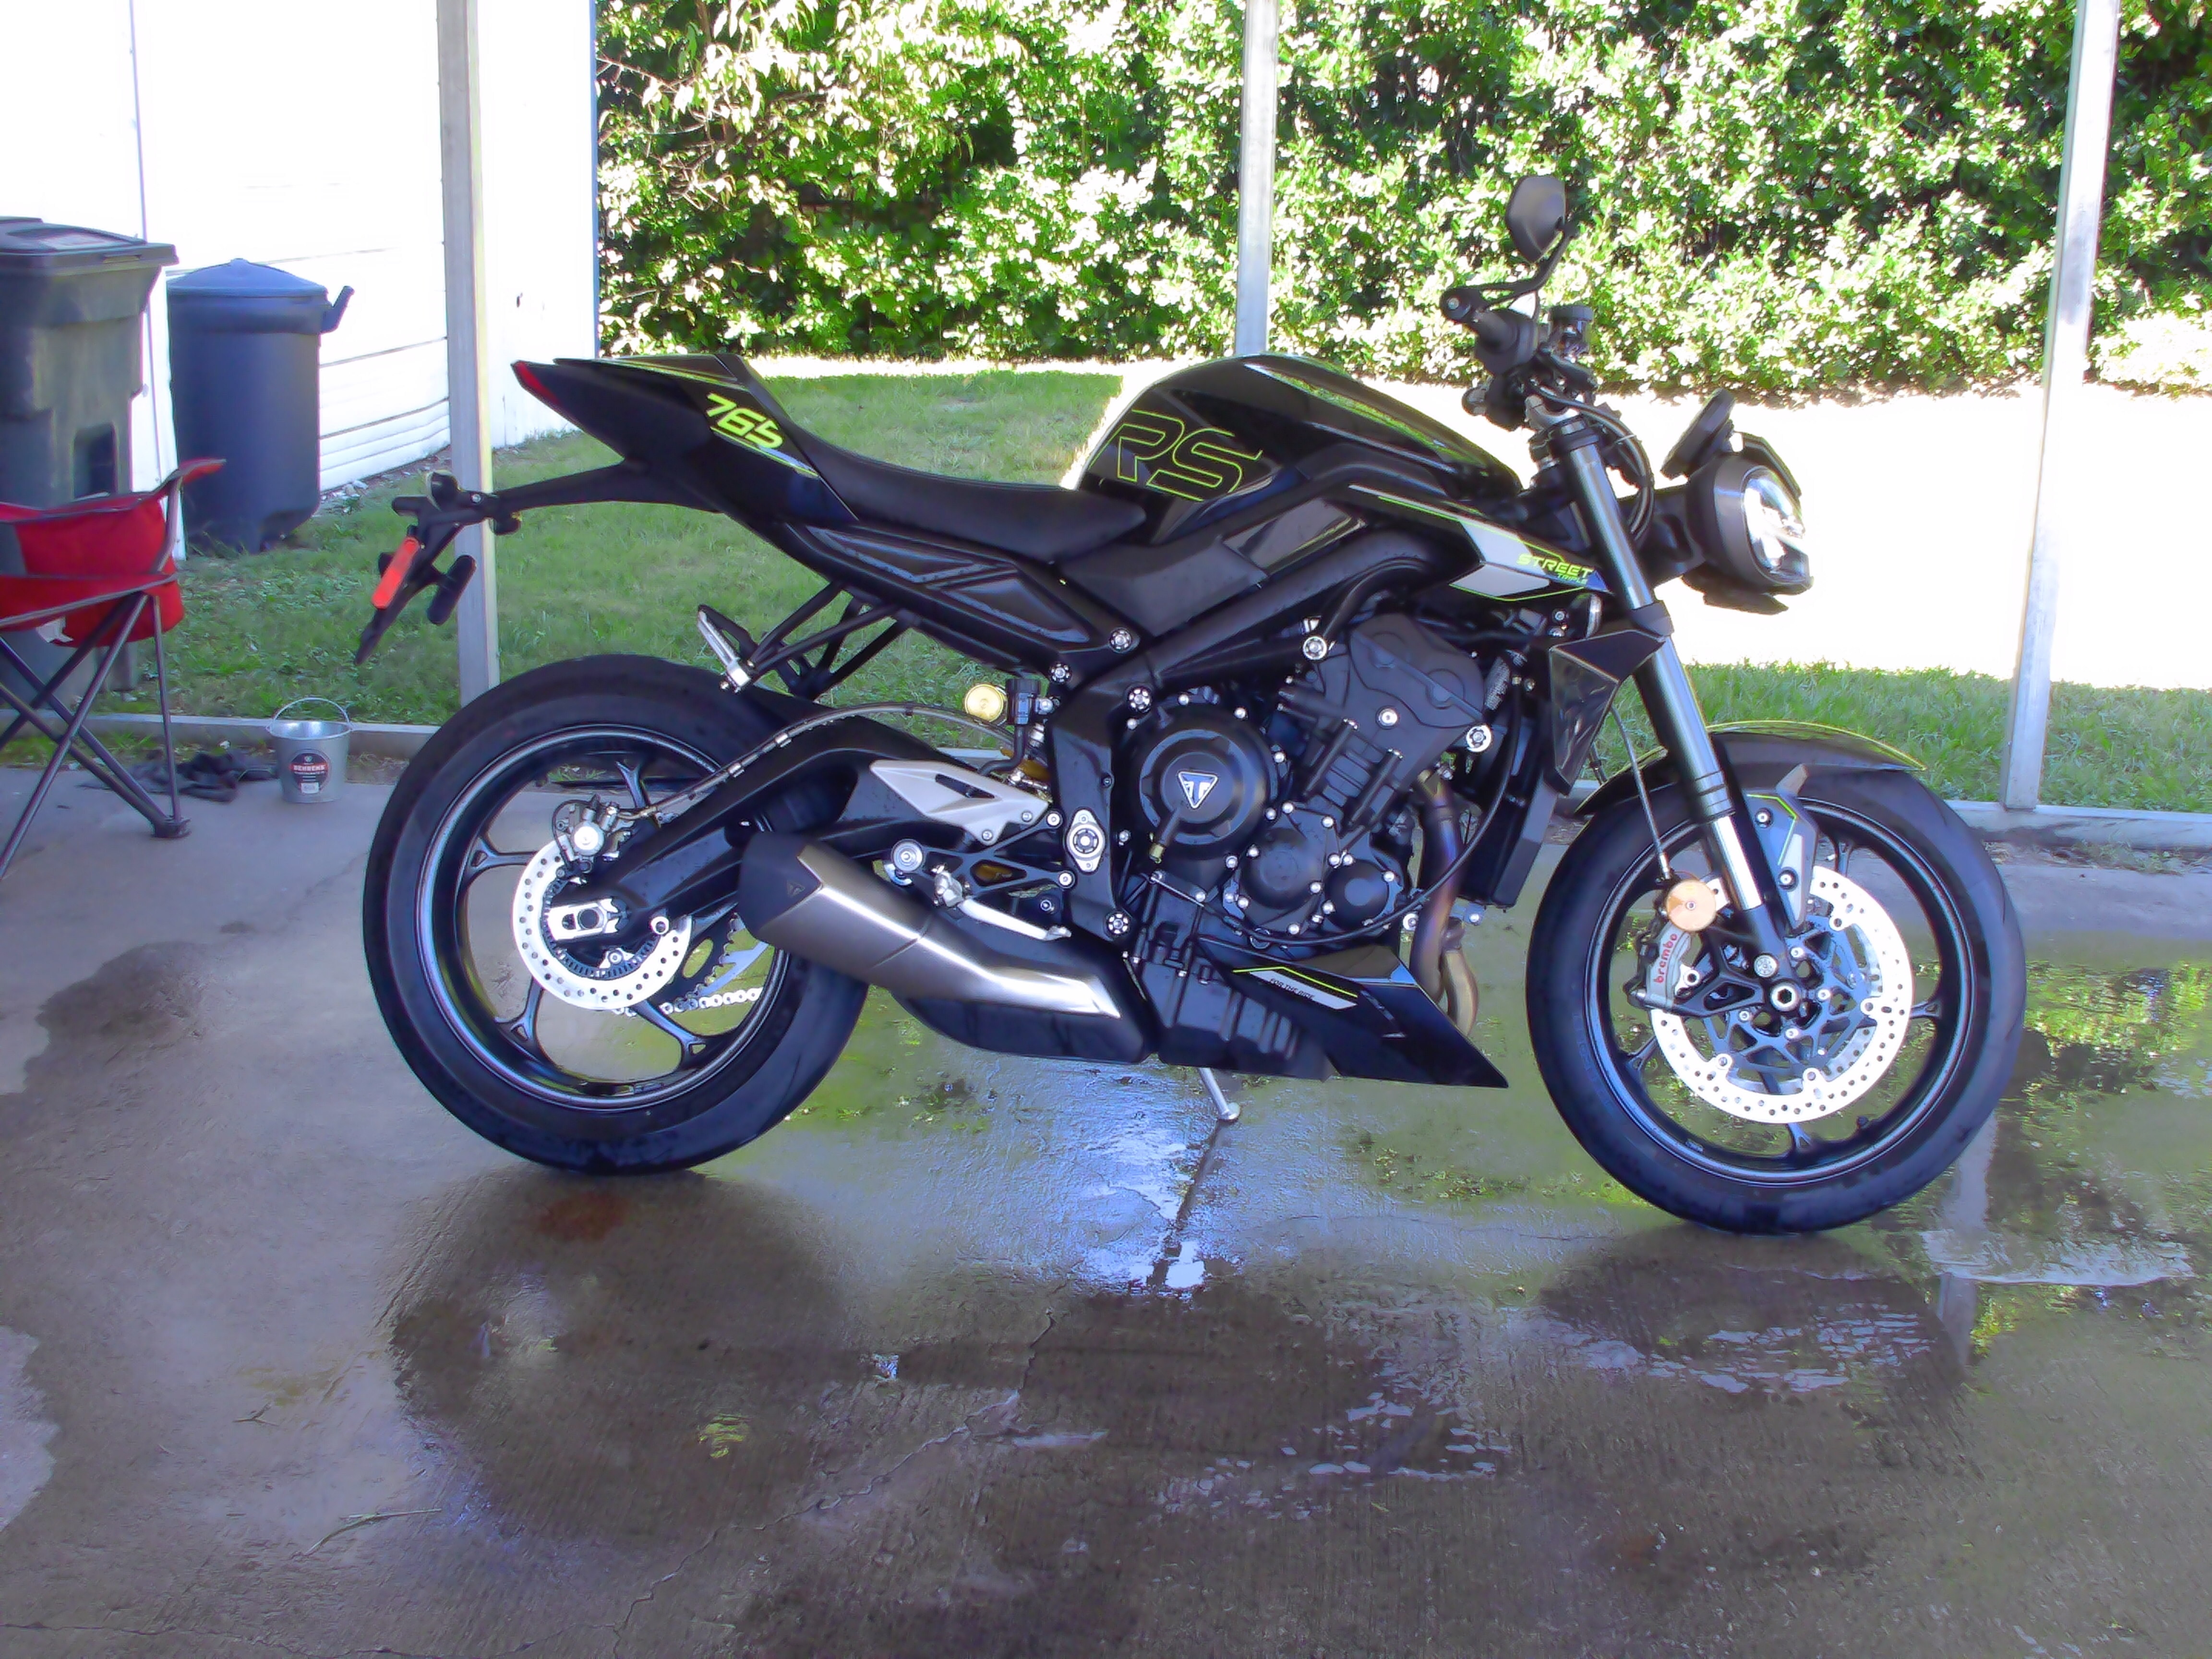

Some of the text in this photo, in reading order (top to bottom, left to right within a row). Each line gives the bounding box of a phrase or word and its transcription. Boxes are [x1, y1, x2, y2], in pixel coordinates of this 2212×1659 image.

[706, 393, 784, 449] 765
[1088, 409, 1263, 502] RS
[1516, 553, 1595, 578] STREET
[1557, 573, 1588, 585] TRIPLE
[1654, 933, 1678, 984] brembo
